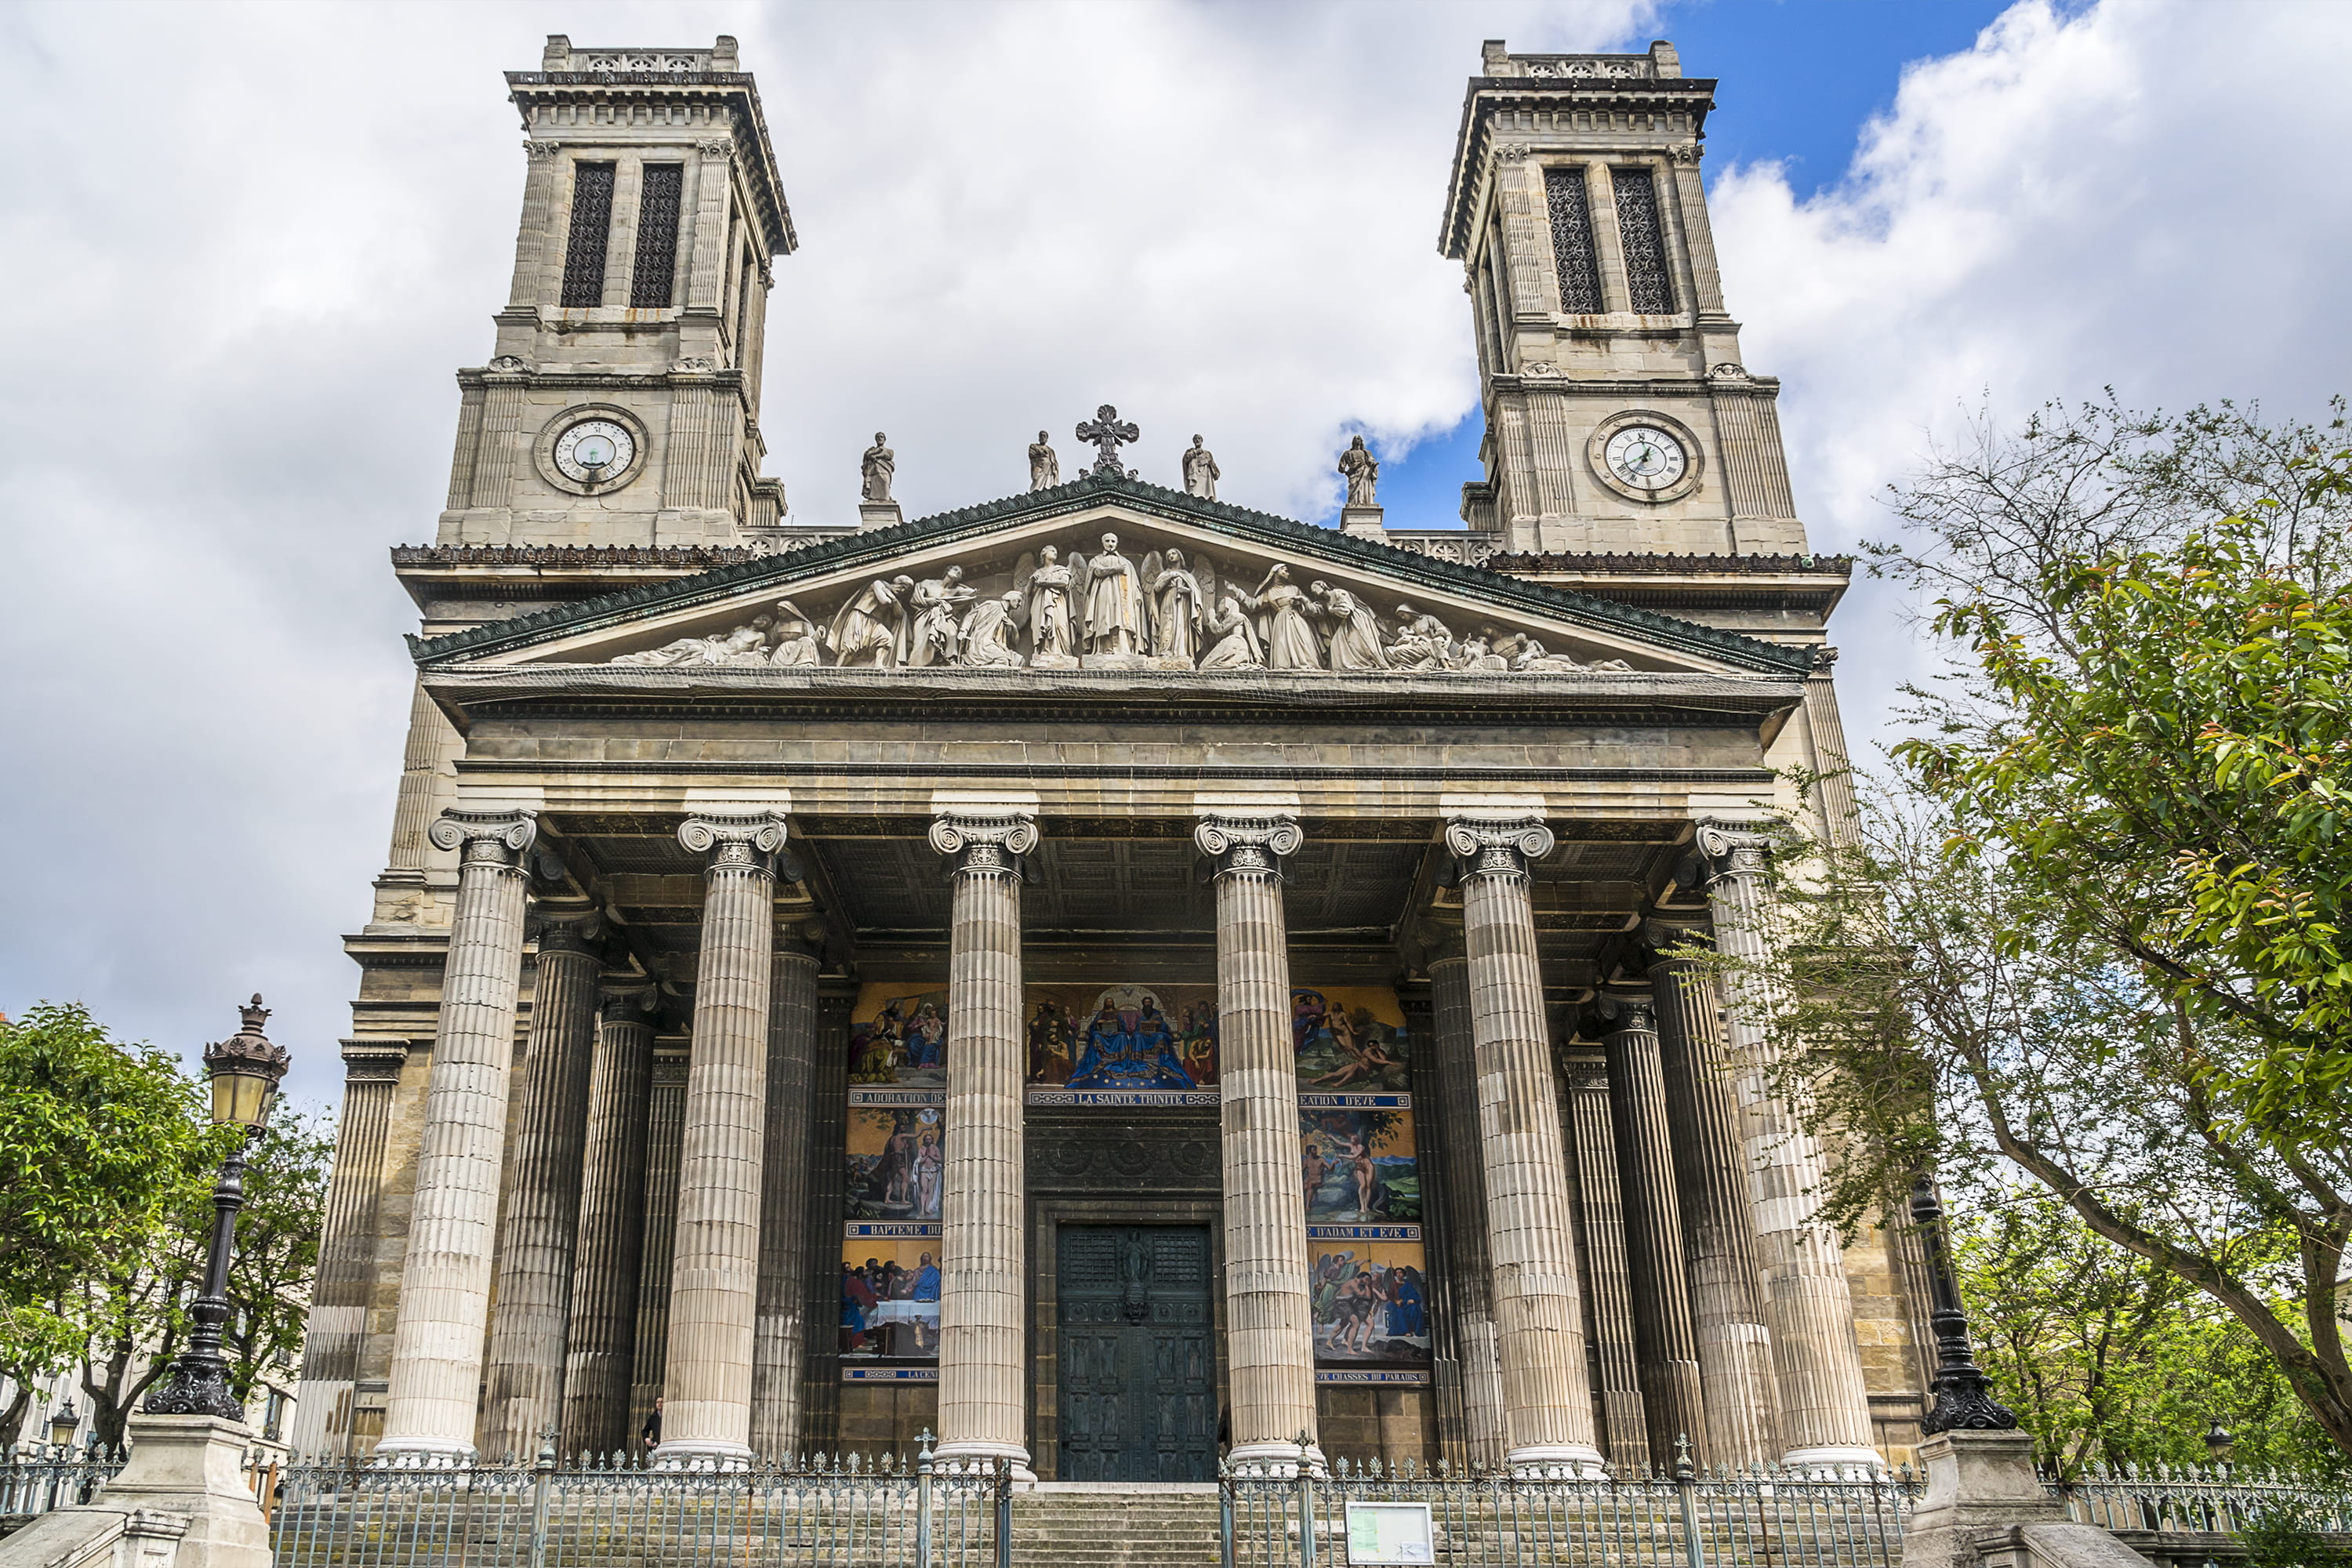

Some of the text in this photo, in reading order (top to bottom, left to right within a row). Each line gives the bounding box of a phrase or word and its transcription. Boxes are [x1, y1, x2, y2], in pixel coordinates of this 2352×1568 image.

[866, 1093, 927, 1103] ADORATION
[1078, 1094, 1183, 1105] LA SAINTE TRINITE
[1345, 1096, 1376, 1105] D'EVE
[871, 1225, 941, 1235] BAPTEME DU
[1317, 1227, 1353, 1237] D'ADAM
[1359, 1227, 1374, 1237] ET
[1380, 1228, 1401, 1237] EVE
